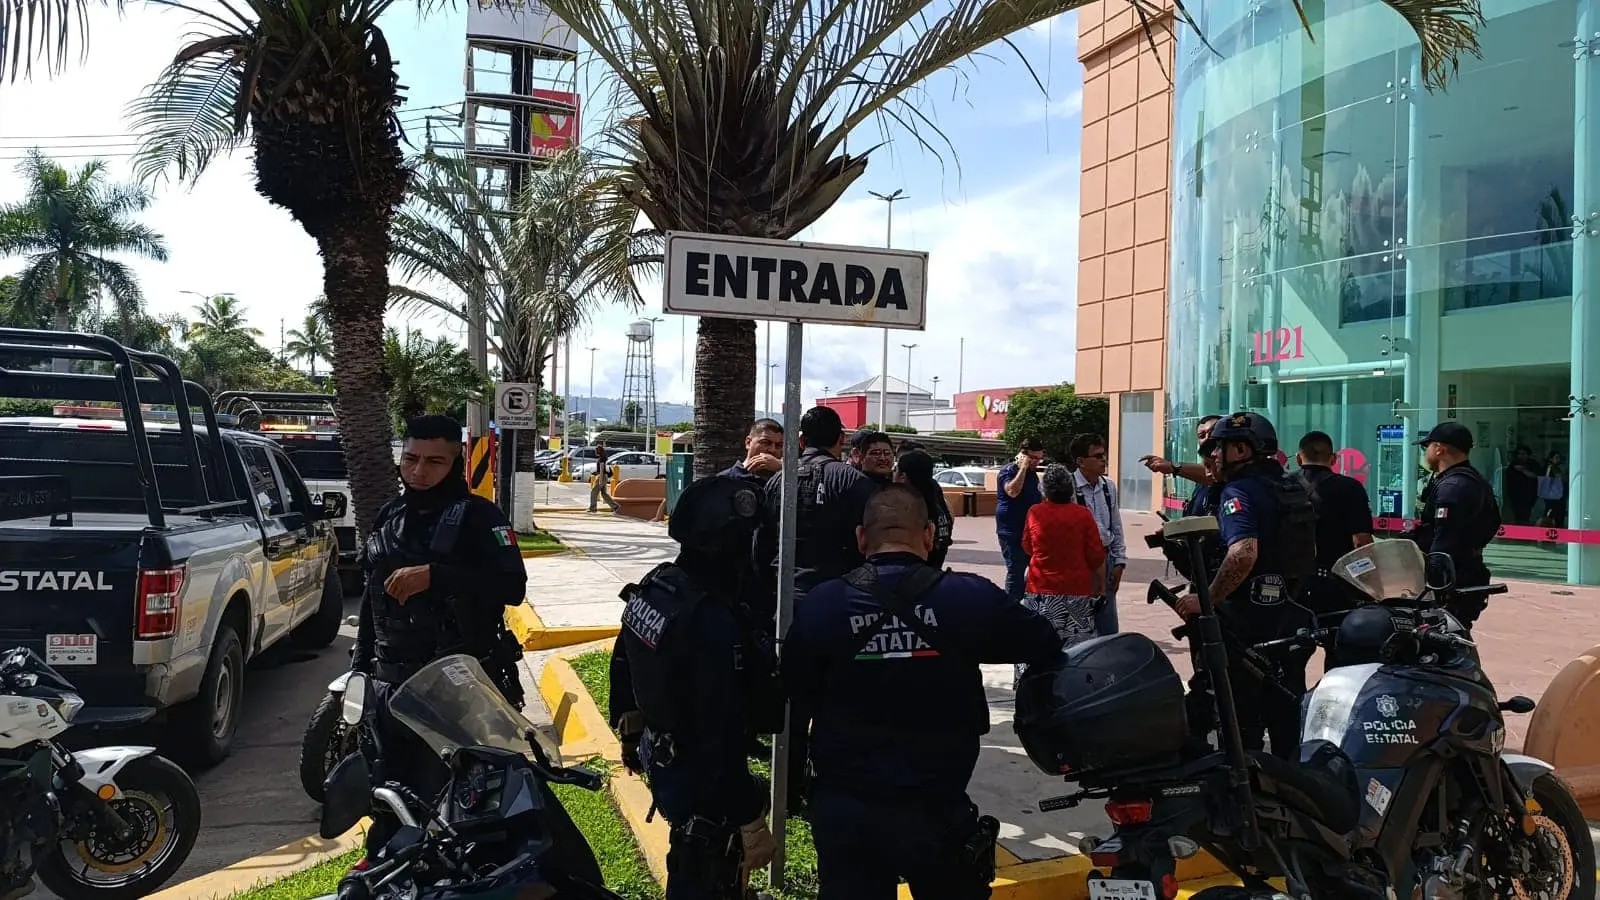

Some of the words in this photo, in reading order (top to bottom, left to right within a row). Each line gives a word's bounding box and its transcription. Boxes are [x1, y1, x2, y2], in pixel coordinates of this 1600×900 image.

[685, 250, 908, 310] ENTRADA
[1252, 325, 1304, 364] 1121
[992, 398, 1009, 413] Sor
[0, 570, 113, 592] STATAL
[627, 592, 666, 634] POLICIA
[849, 604, 939, 634] POLIA
[623, 608, 657, 646] ESTATAL
[859, 631, 931, 653] STATA
[1363, 719, 1417, 731] POLICIA
[1365, 733, 1419, 744] ESTATAL
